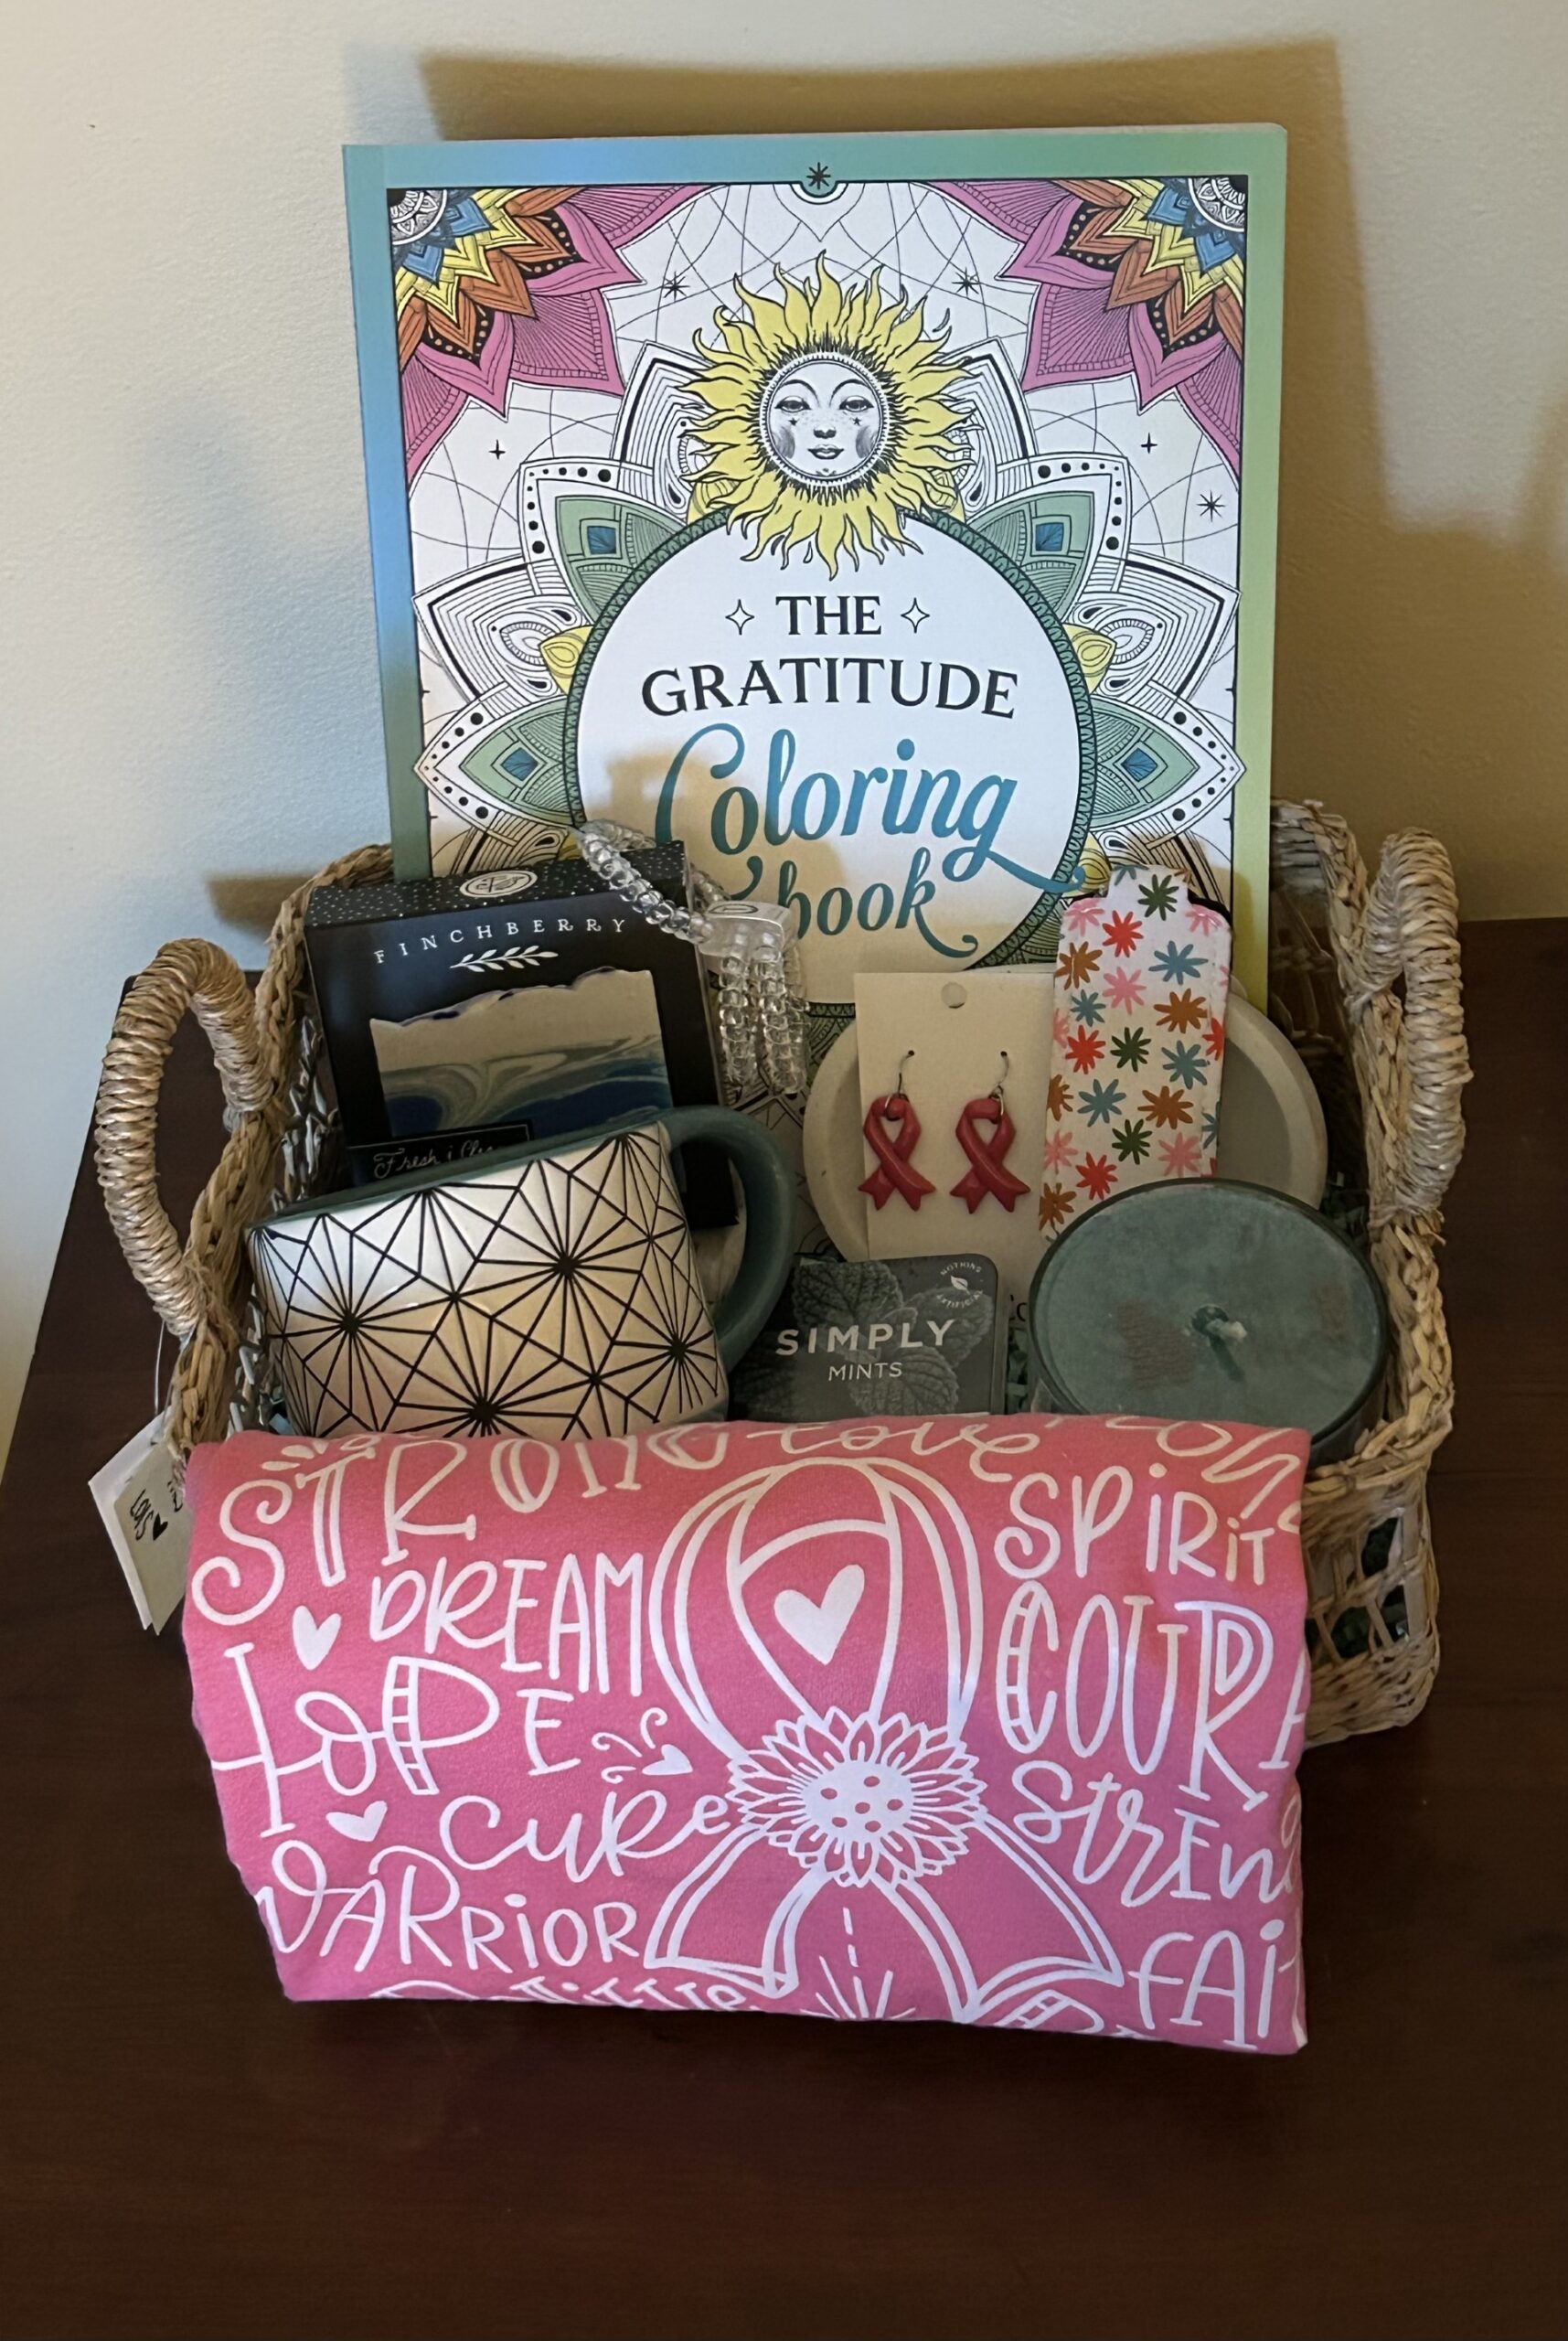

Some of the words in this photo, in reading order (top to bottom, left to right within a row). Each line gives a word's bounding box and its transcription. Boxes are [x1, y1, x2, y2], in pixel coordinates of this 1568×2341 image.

[775, 595, 882, 636] THE
[642, 657, 1019, 719] GRATITUDE
[655, 722, 1085, 901] Coloring
[374, 917, 626, 965] FINCHBERRY
[373, 1147, 441, 1180] Fresh
[775, 1319, 955, 1356] SIMPLY
[827, 1362, 903, 1382] MINTS
[369, 1552, 644, 1697] DREAM
